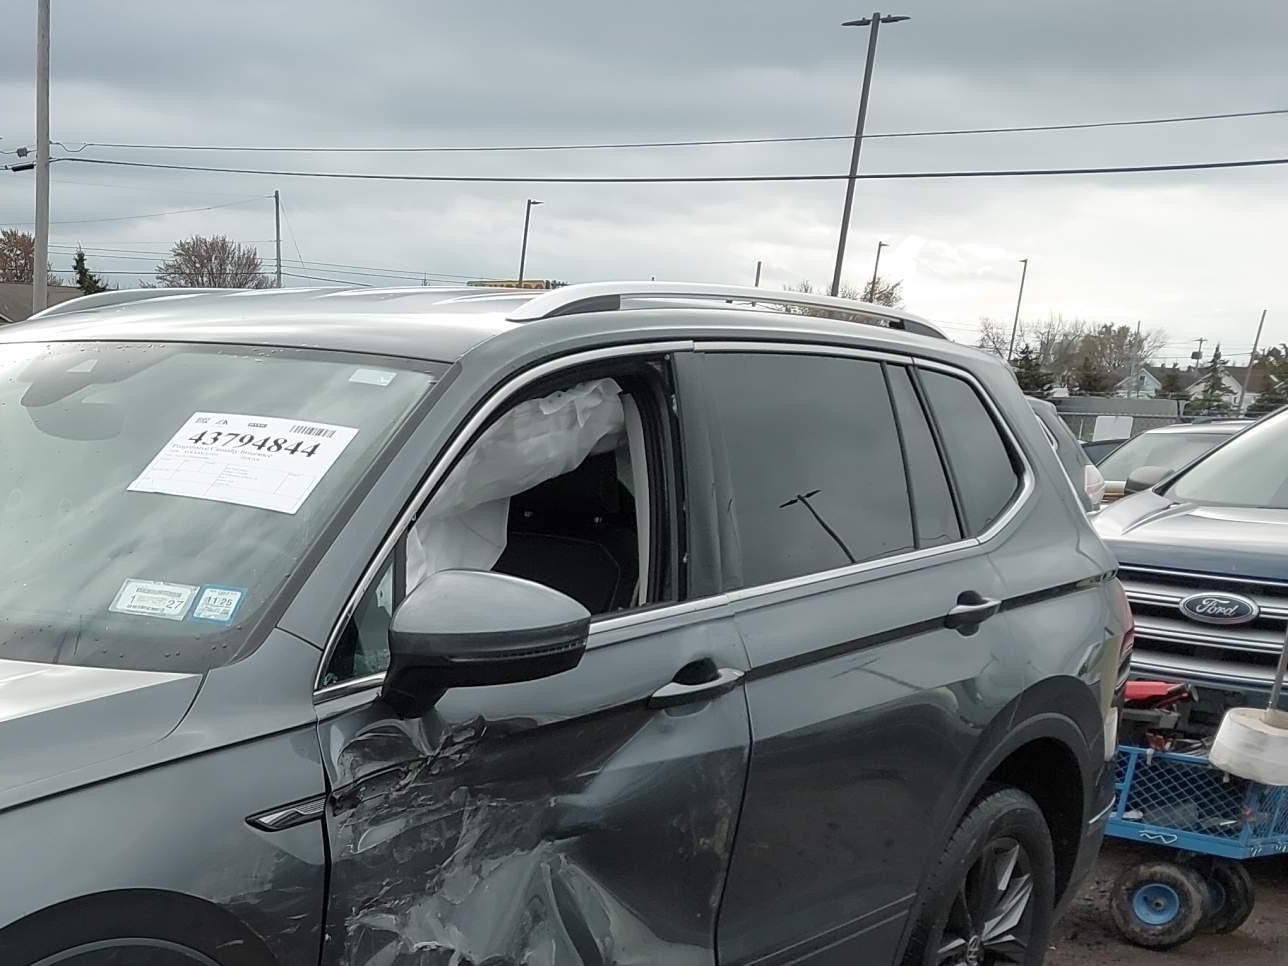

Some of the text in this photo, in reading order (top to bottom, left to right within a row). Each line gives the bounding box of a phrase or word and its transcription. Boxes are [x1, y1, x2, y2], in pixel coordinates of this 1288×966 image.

[188, 430, 321, 458] 43794844
[165, 599, 185, 610] 27
[1195, 598, 1240, 617] Ford
